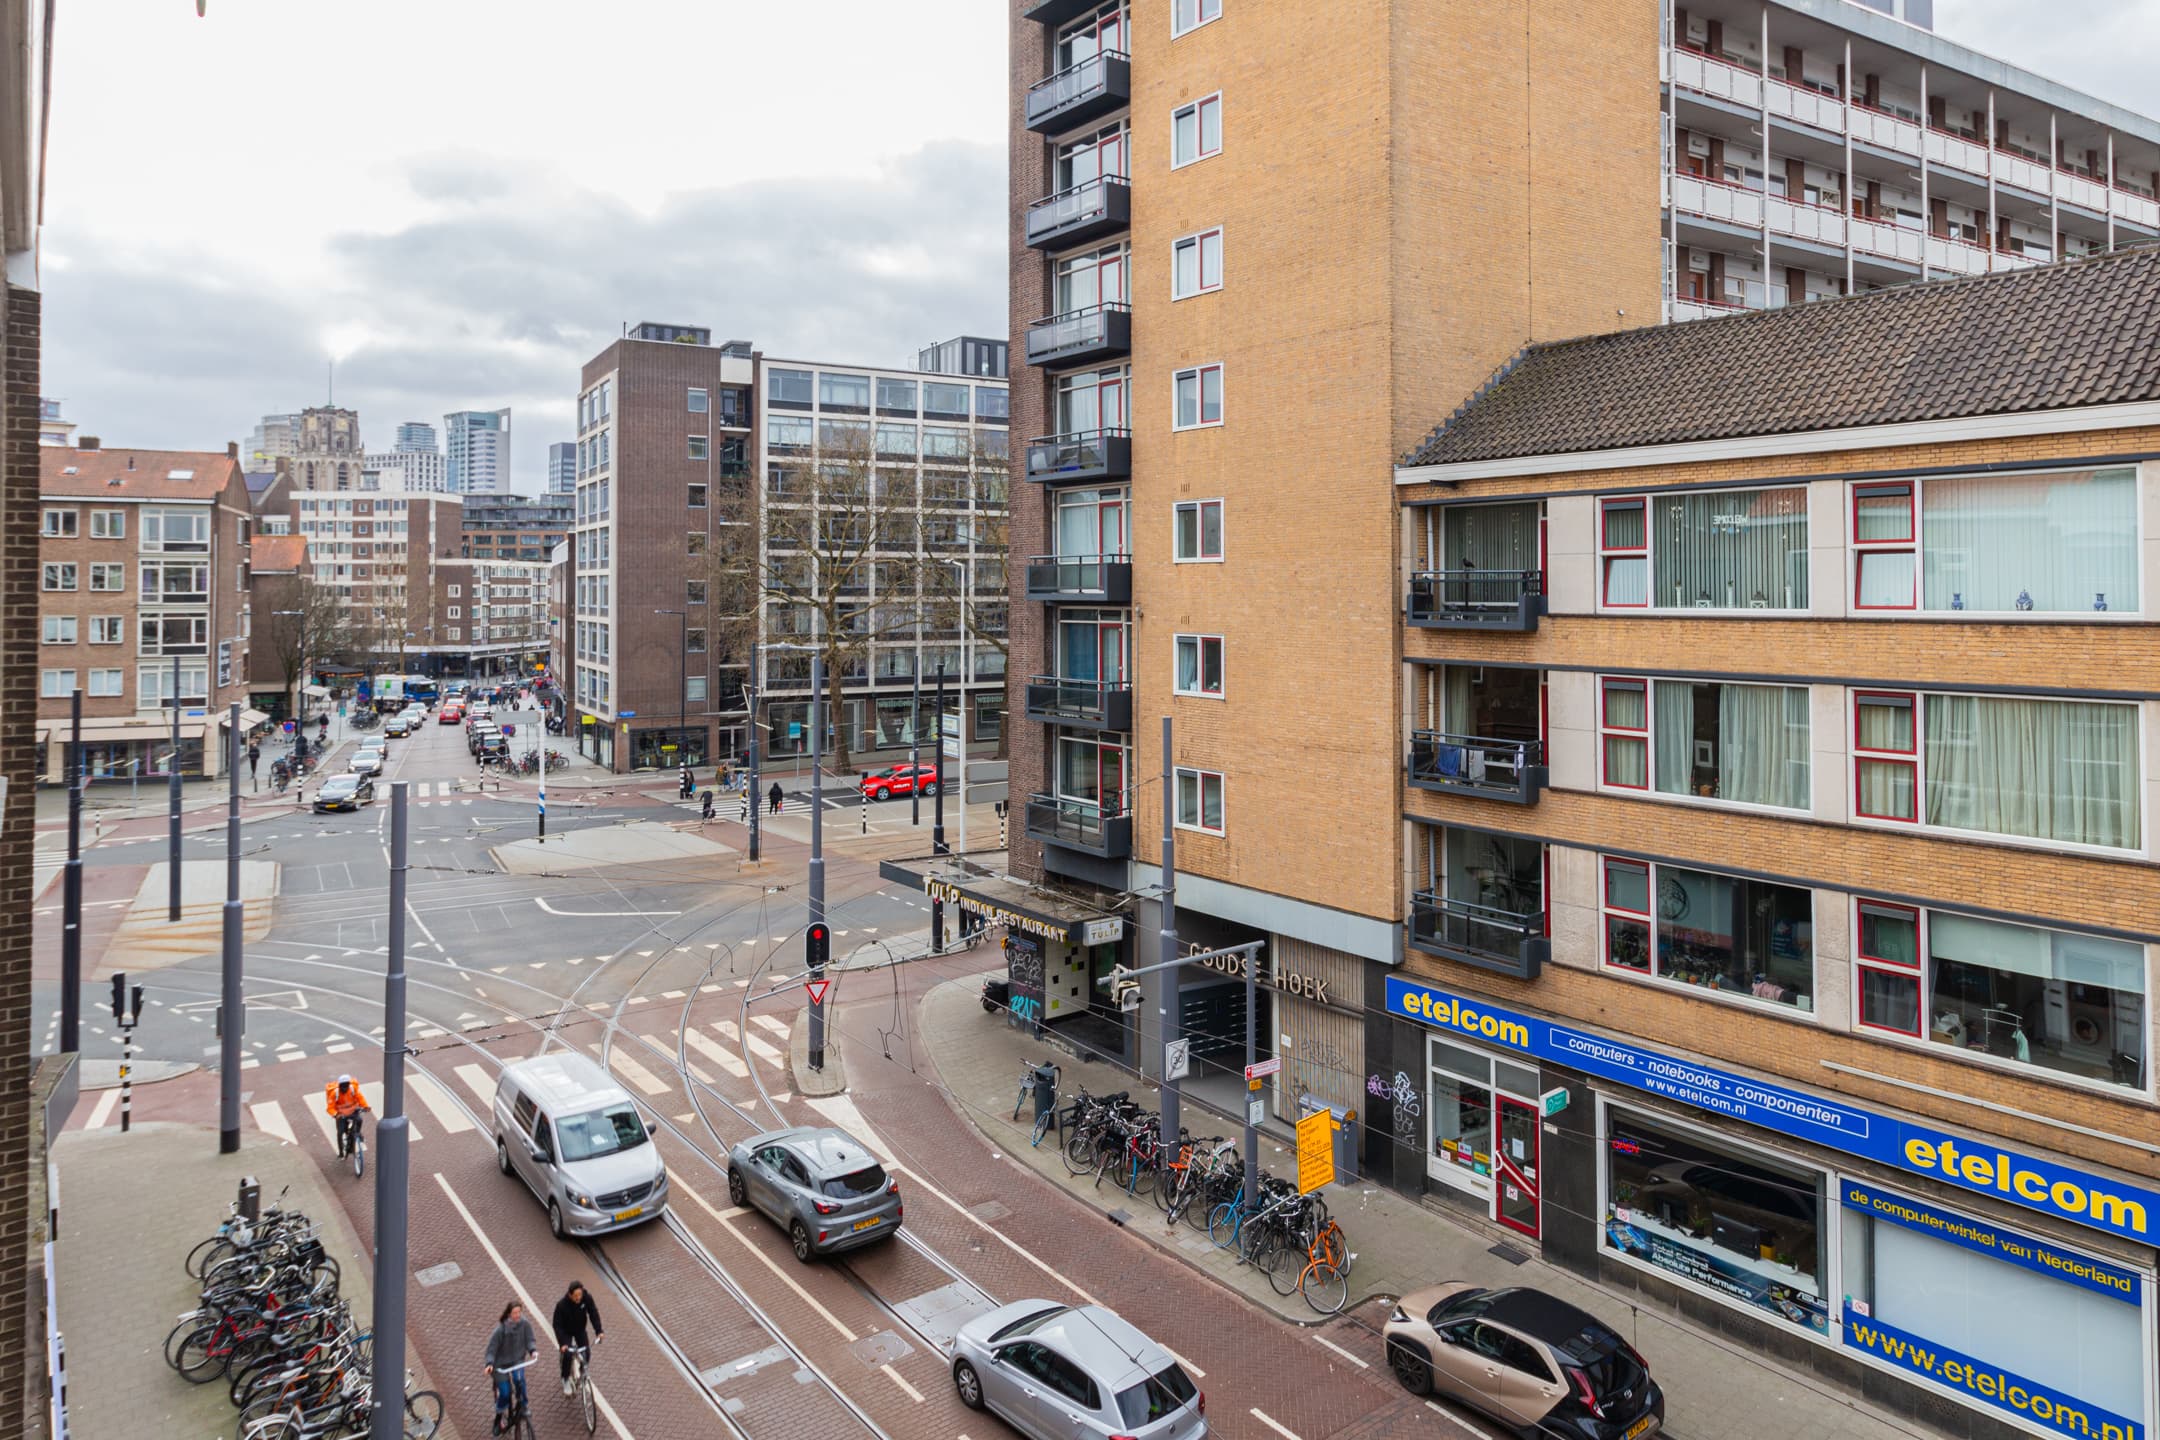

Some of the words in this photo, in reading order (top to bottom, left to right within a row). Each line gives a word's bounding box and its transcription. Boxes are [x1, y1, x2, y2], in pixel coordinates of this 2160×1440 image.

[923, 875, 959, 904] TULIP
[960, 897, 996, 920] INDIAN
[996, 908, 1068, 943] RESTAURANT
[1091, 928, 1119, 939] TULIP
[1275, 969, 1328, 1004] HOEK
[1403, 992, 1529, 1047] etelcom
[1568, 1037, 1634, 1065] computers
[1648, 1059, 1720, 1091] notebooks
[1735, 1084, 1841, 1126] componenten
[1645, 1077, 1747, 1116] www.etelcom.nl
[1904, 1139, 2147, 1233] etelcom
[1850, 1189, 1868, 1205] de
[1873, 1199, 1995, 1247] computerwinkel
[2000, 1240, 2031, 1259] van
[2037, 1249, 2131, 1293] Nederland
[1652, 1253, 1690, 1273] Absolute
[1692, 1268, 1752, 1298] Performance
[1852, 1322, 2134, 1440] www.etelcom.nl
